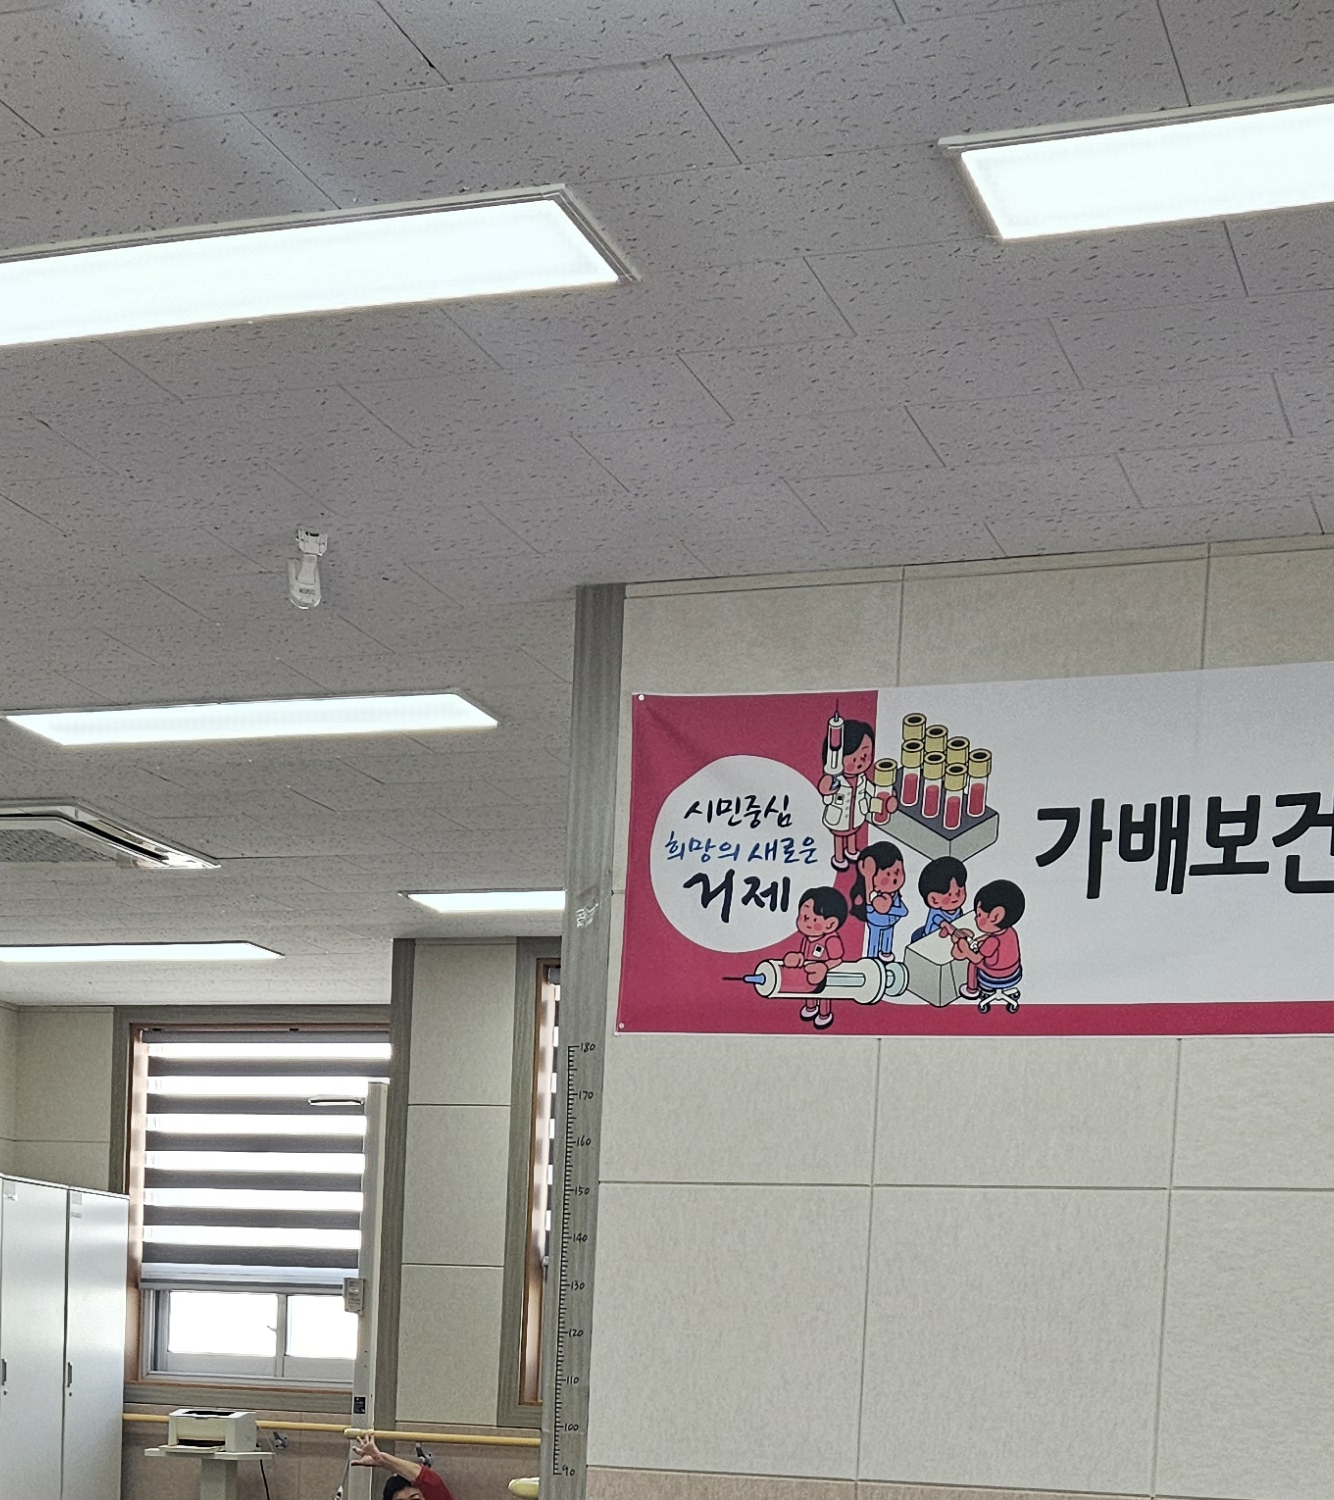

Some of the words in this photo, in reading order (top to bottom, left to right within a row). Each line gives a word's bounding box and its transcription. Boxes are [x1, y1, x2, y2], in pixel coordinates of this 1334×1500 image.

[682, 793, 794, 830] 시민중심
[664, 830, 741, 863] 희망의
[746, 835, 819, 865] 새로운
[682, 869, 791, 924] 거제
[580, 1042, 596, 1053] 180
[578, 1091, 594, 1100] 170
[576, 1136, 592, 1147] 160
[574, 1187, 590, 1196] 150
[572, 1233, 589, 1243] 140
[570, 1280, 585, 1290] 130
[568, 1328, 584, 1338] 120
[566, 1376, 579, 1385] 110
[564, 1423, 579, 1432] 100
[562, 1465, 575, 1476] 90
